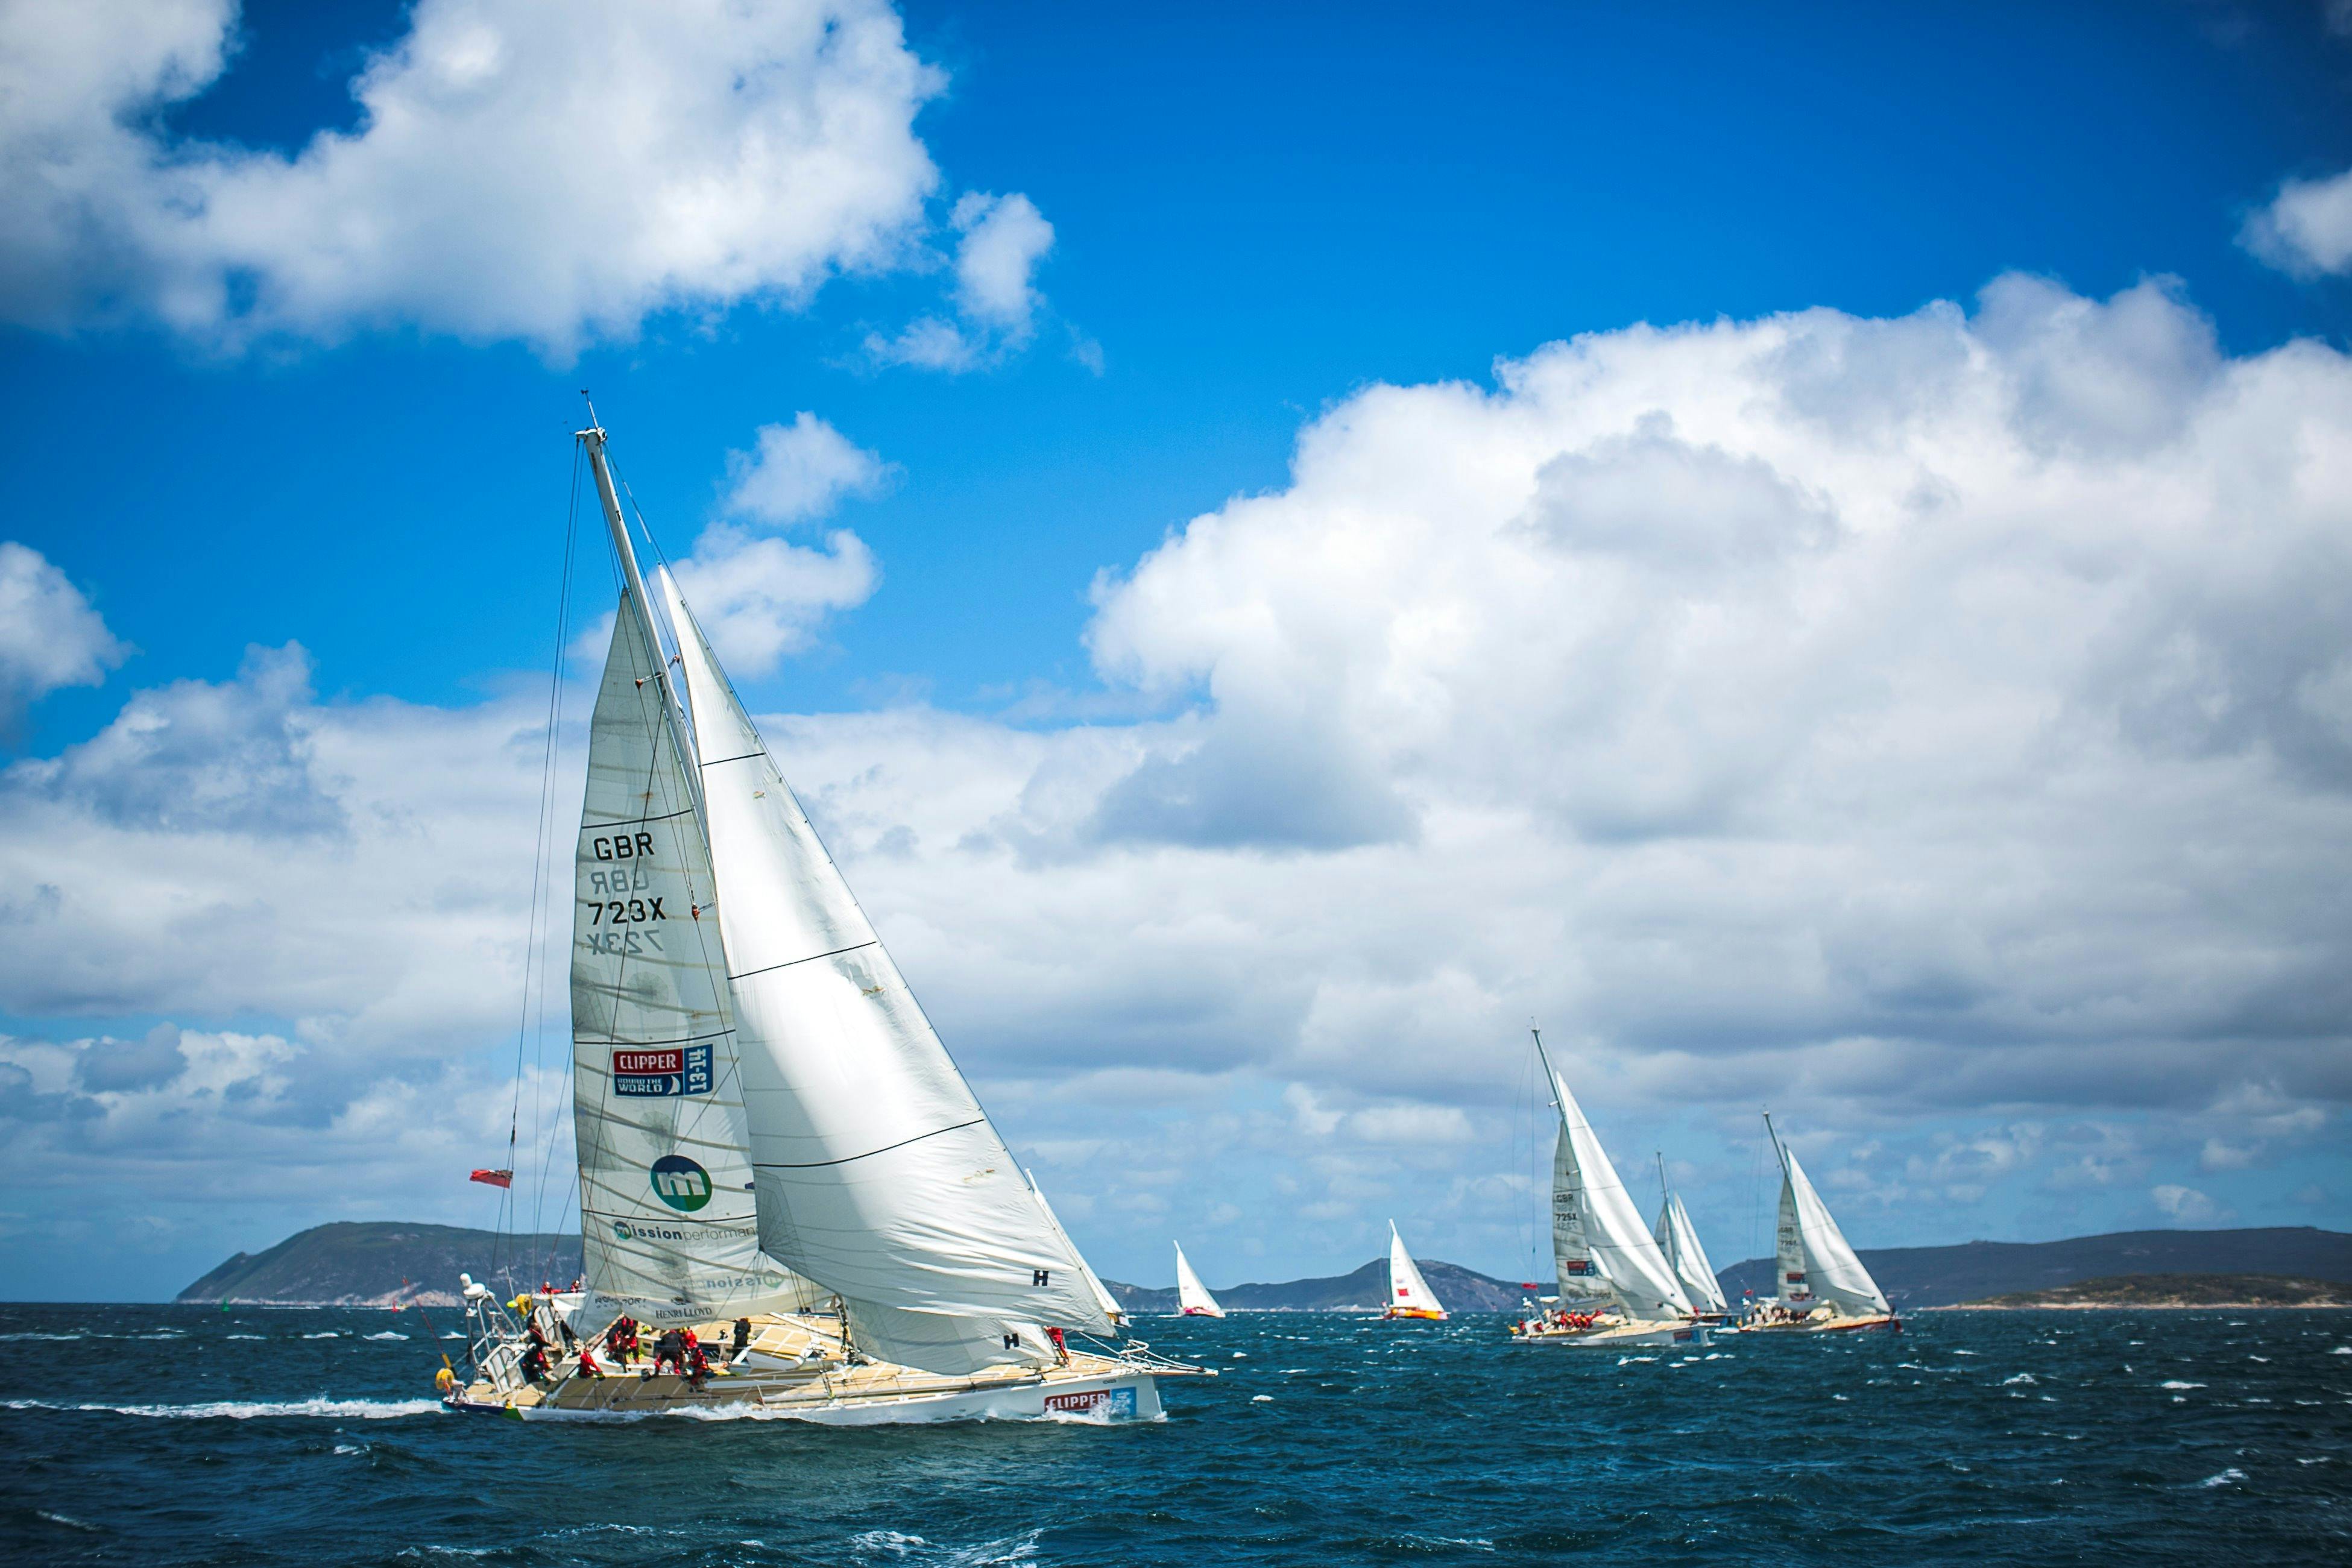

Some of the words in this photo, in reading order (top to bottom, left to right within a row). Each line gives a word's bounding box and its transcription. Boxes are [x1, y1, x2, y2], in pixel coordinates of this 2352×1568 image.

[593, 832, 655, 860] GBR
[588, 897, 666, 925] 723X
[620, 1054, 676, 1069] CLIPPER
[689, 1048, 707, 1091] 13-14
[619, 1084, 663, 1092] WORLD
[1033, 1270, 1049, 1286] H
[656, 1309, 683, 1319] HENRI
[684, 1308, 713, 1318] LLOYD
[1003, 1333, 1020, 1350] H
